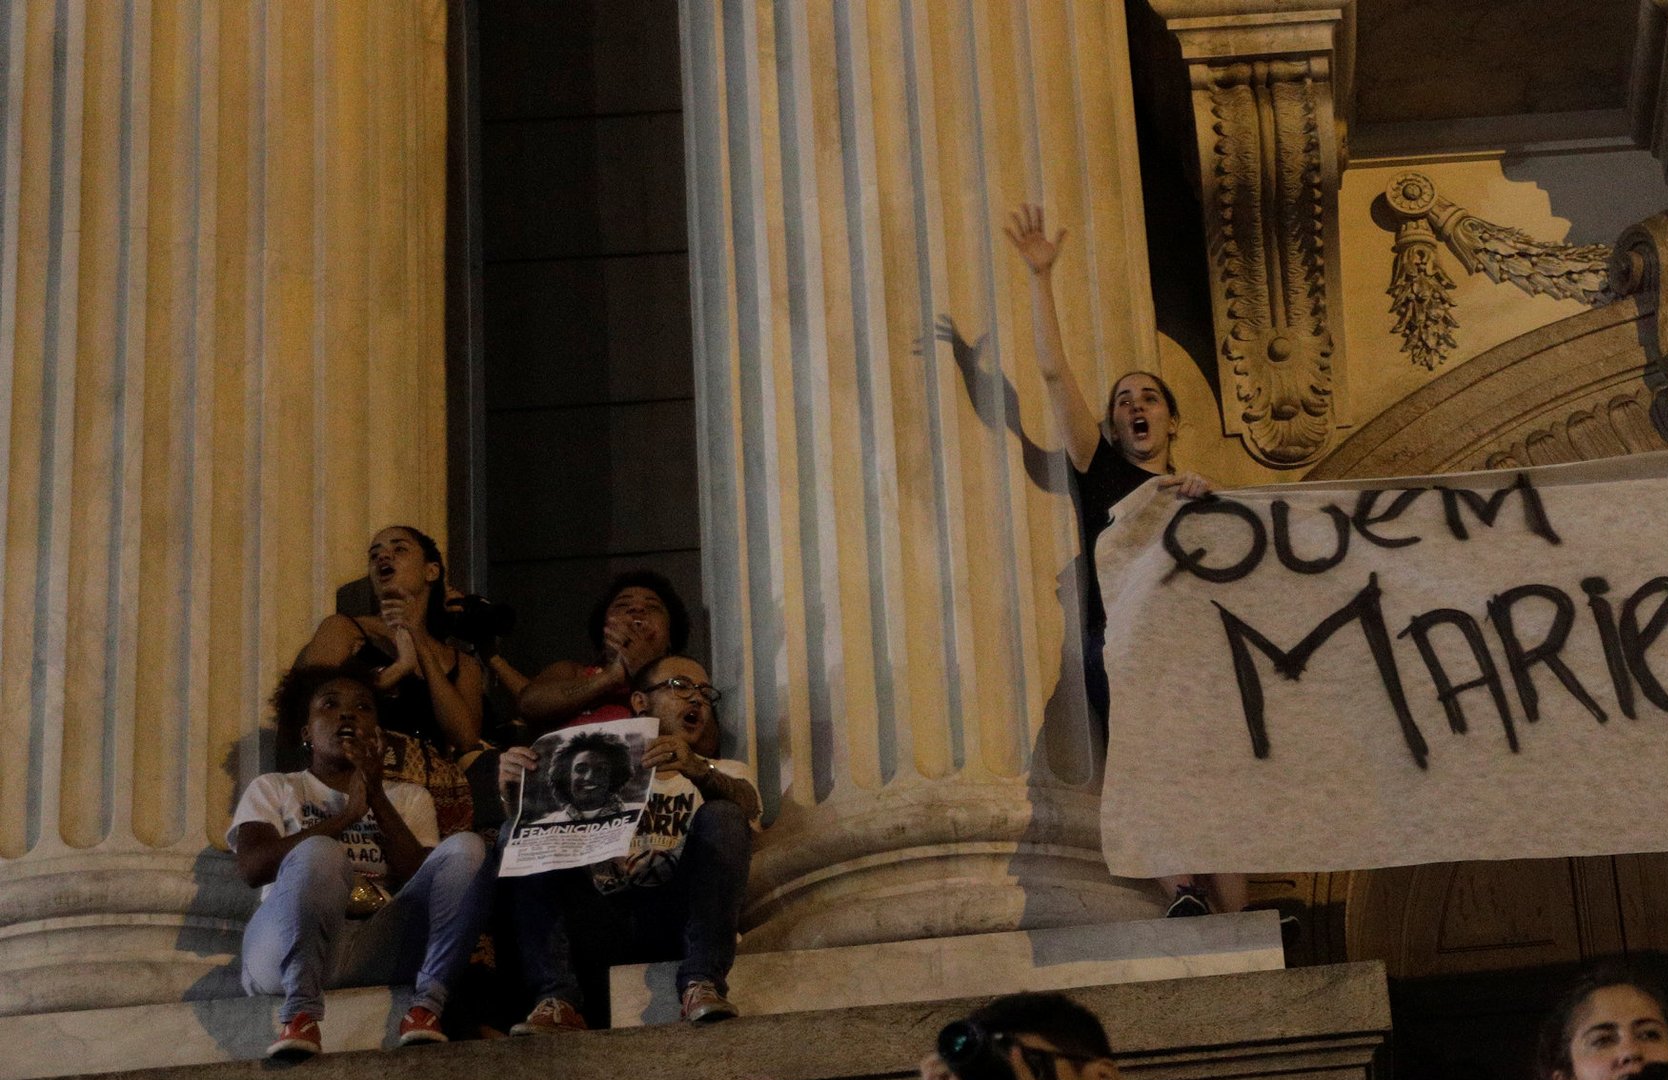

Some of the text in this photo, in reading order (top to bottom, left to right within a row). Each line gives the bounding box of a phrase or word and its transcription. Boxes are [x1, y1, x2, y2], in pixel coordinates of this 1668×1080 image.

[1162, 471, 1562, 584] QUEM
[520, 814, 633, 839] FEMINICIDADE
[636, 810, 691, 837] ARK
[360, 848, 390, 864] ACA
